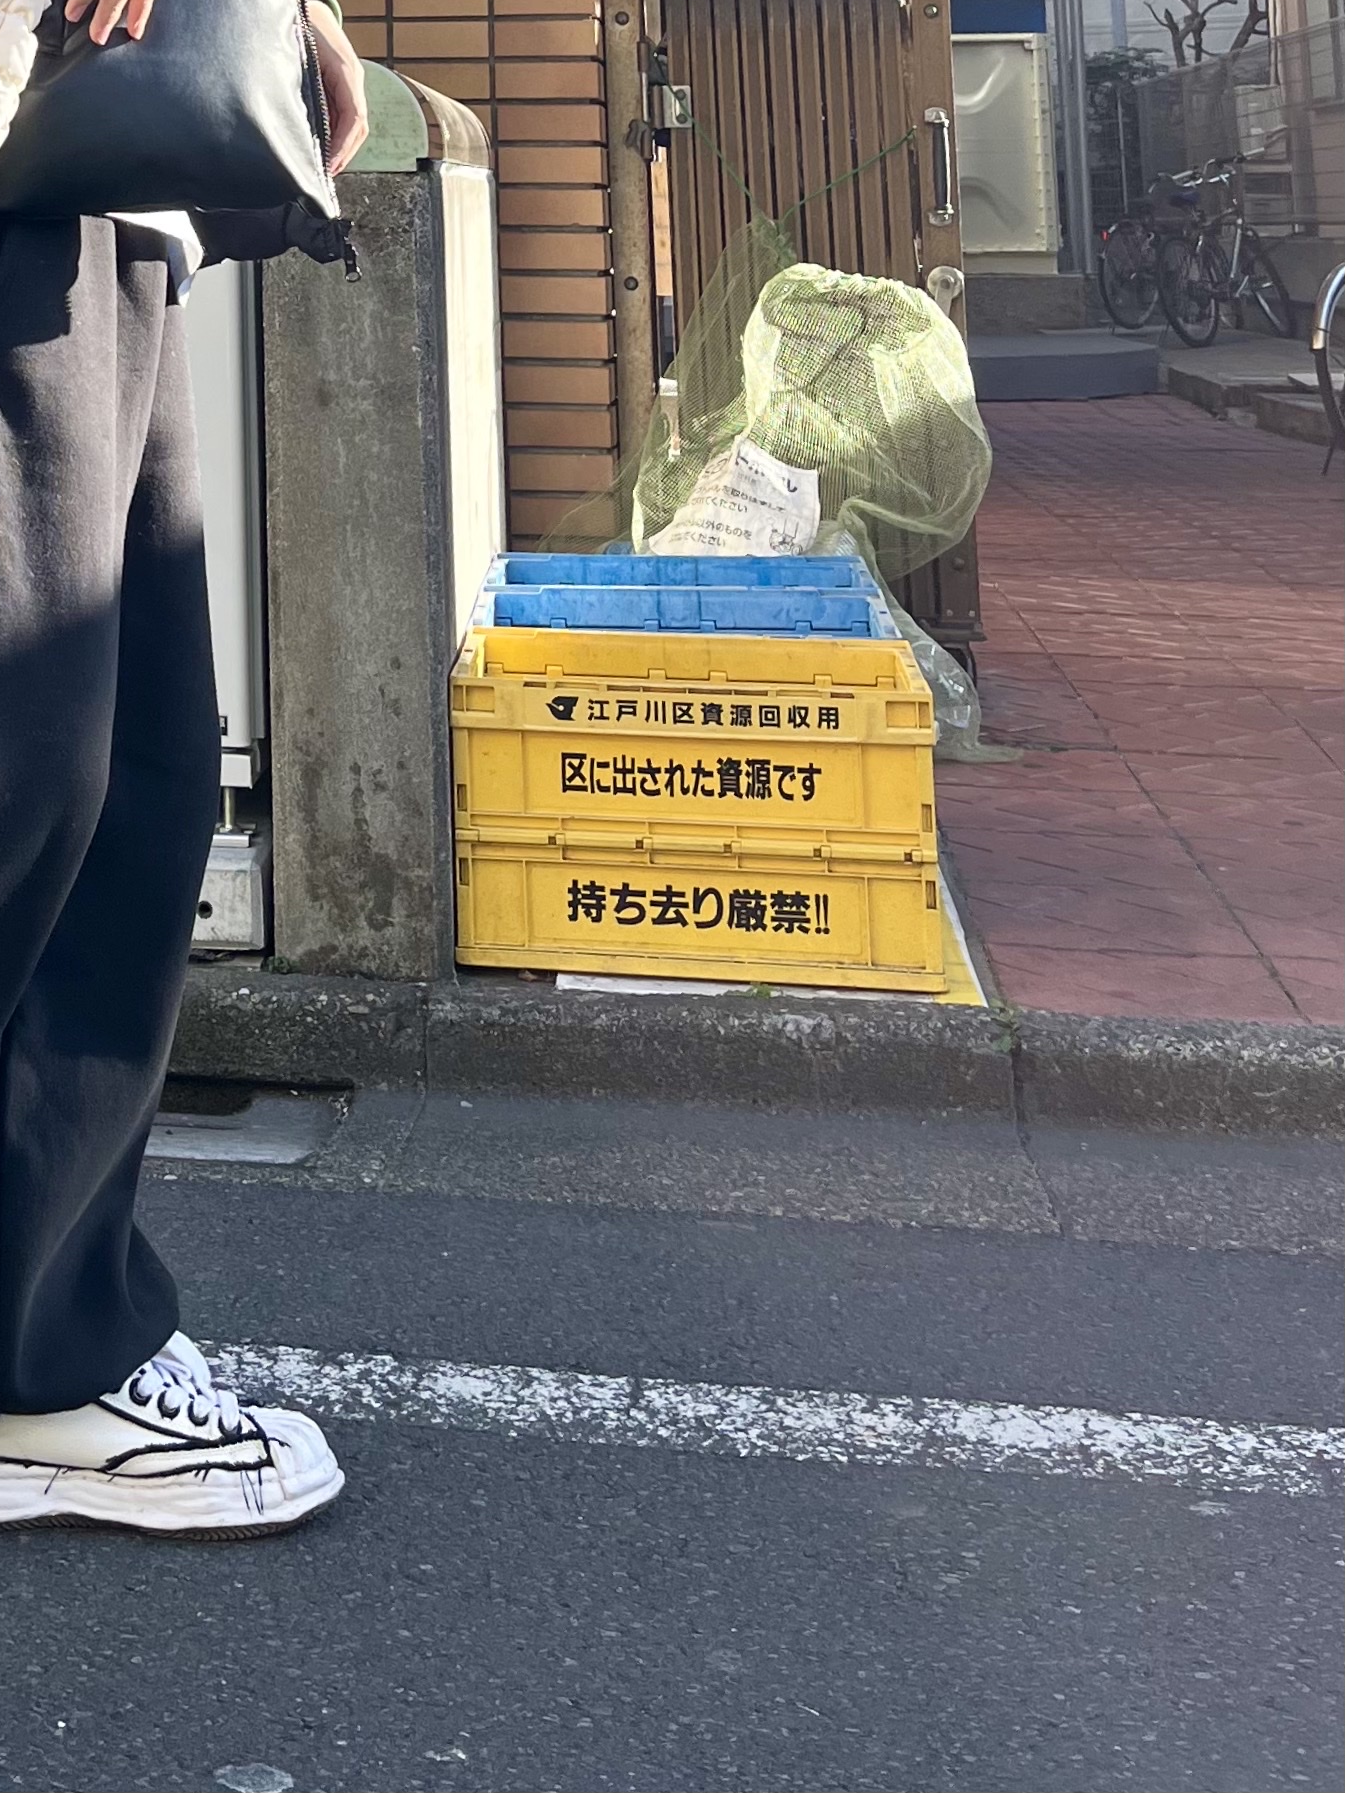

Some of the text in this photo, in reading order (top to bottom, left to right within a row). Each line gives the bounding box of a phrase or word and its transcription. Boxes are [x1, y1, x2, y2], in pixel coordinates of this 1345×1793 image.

[587, 698, 840, 730] 江戸川区資源回収用
[560, 751, 823, 802] 区に出された資源です
[567, 878, 831, 935] 持ち去り厳禁!!
